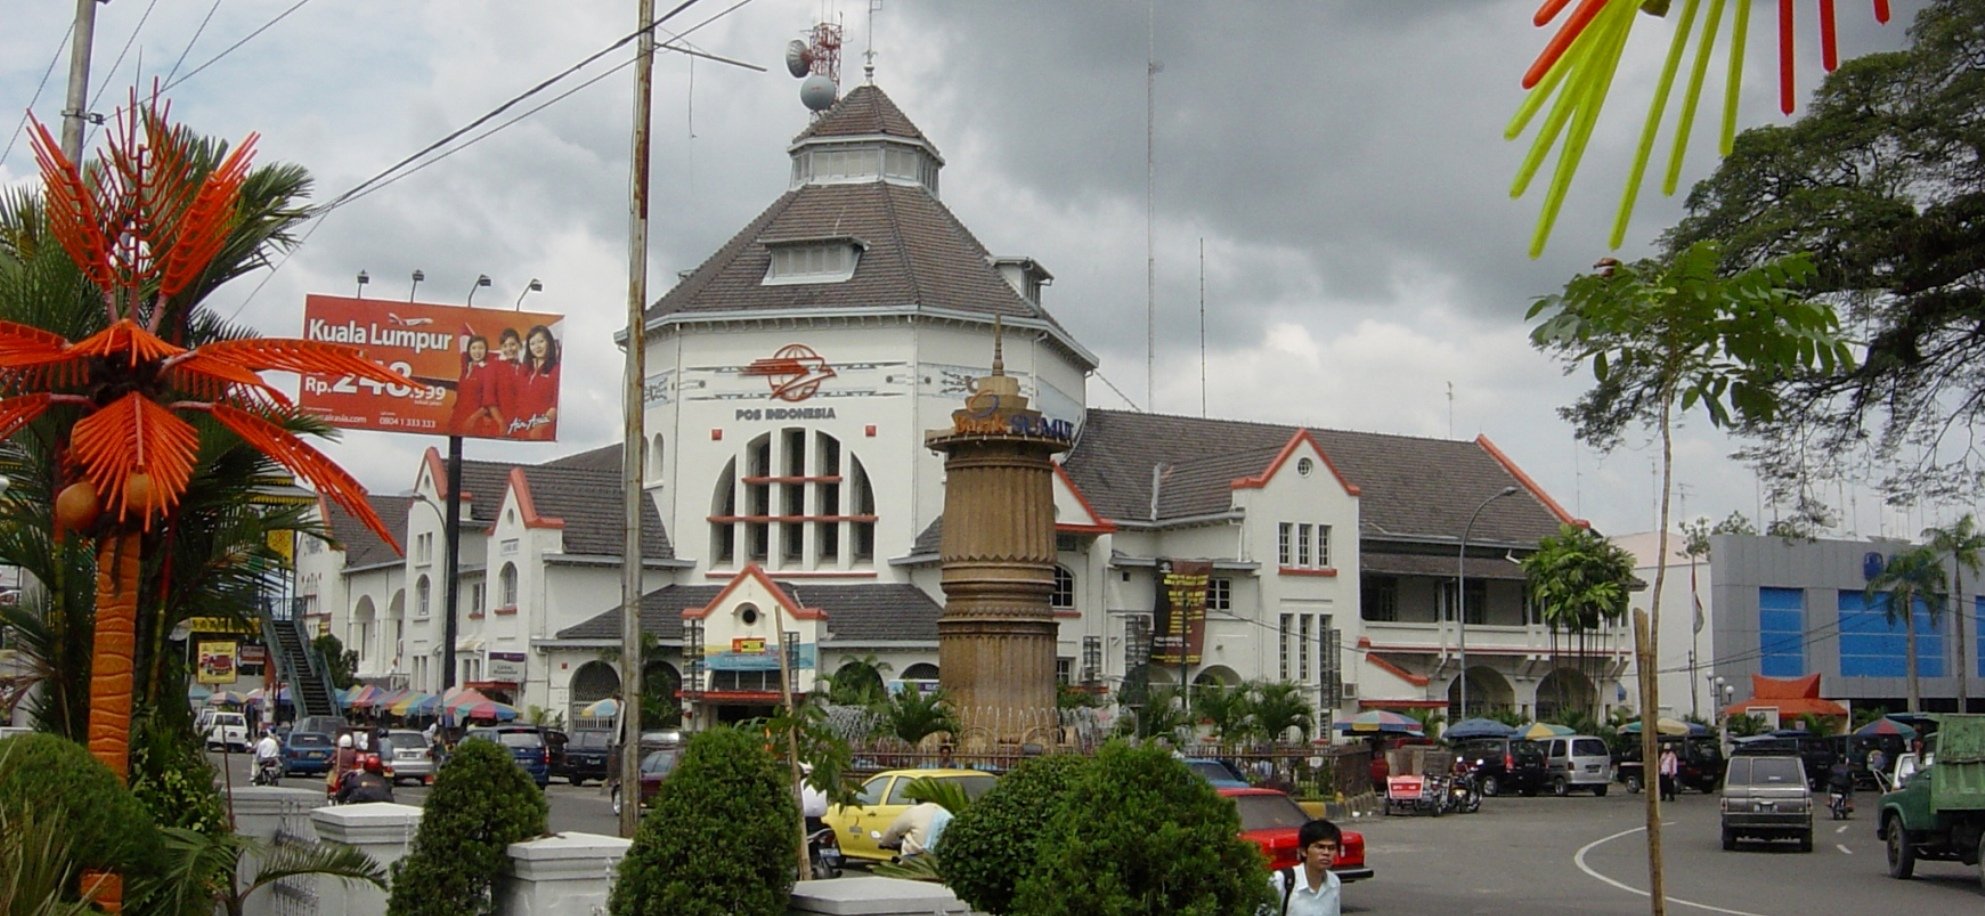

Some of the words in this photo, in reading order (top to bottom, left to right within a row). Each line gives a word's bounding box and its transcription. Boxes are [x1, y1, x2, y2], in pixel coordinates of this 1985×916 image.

[309, 318, 367, 344] Kuala
[370, 323, 453, 354] Lumpur
[736, 409, 761, 421] POS
[765, 407, 836, 420] INDONESIA
